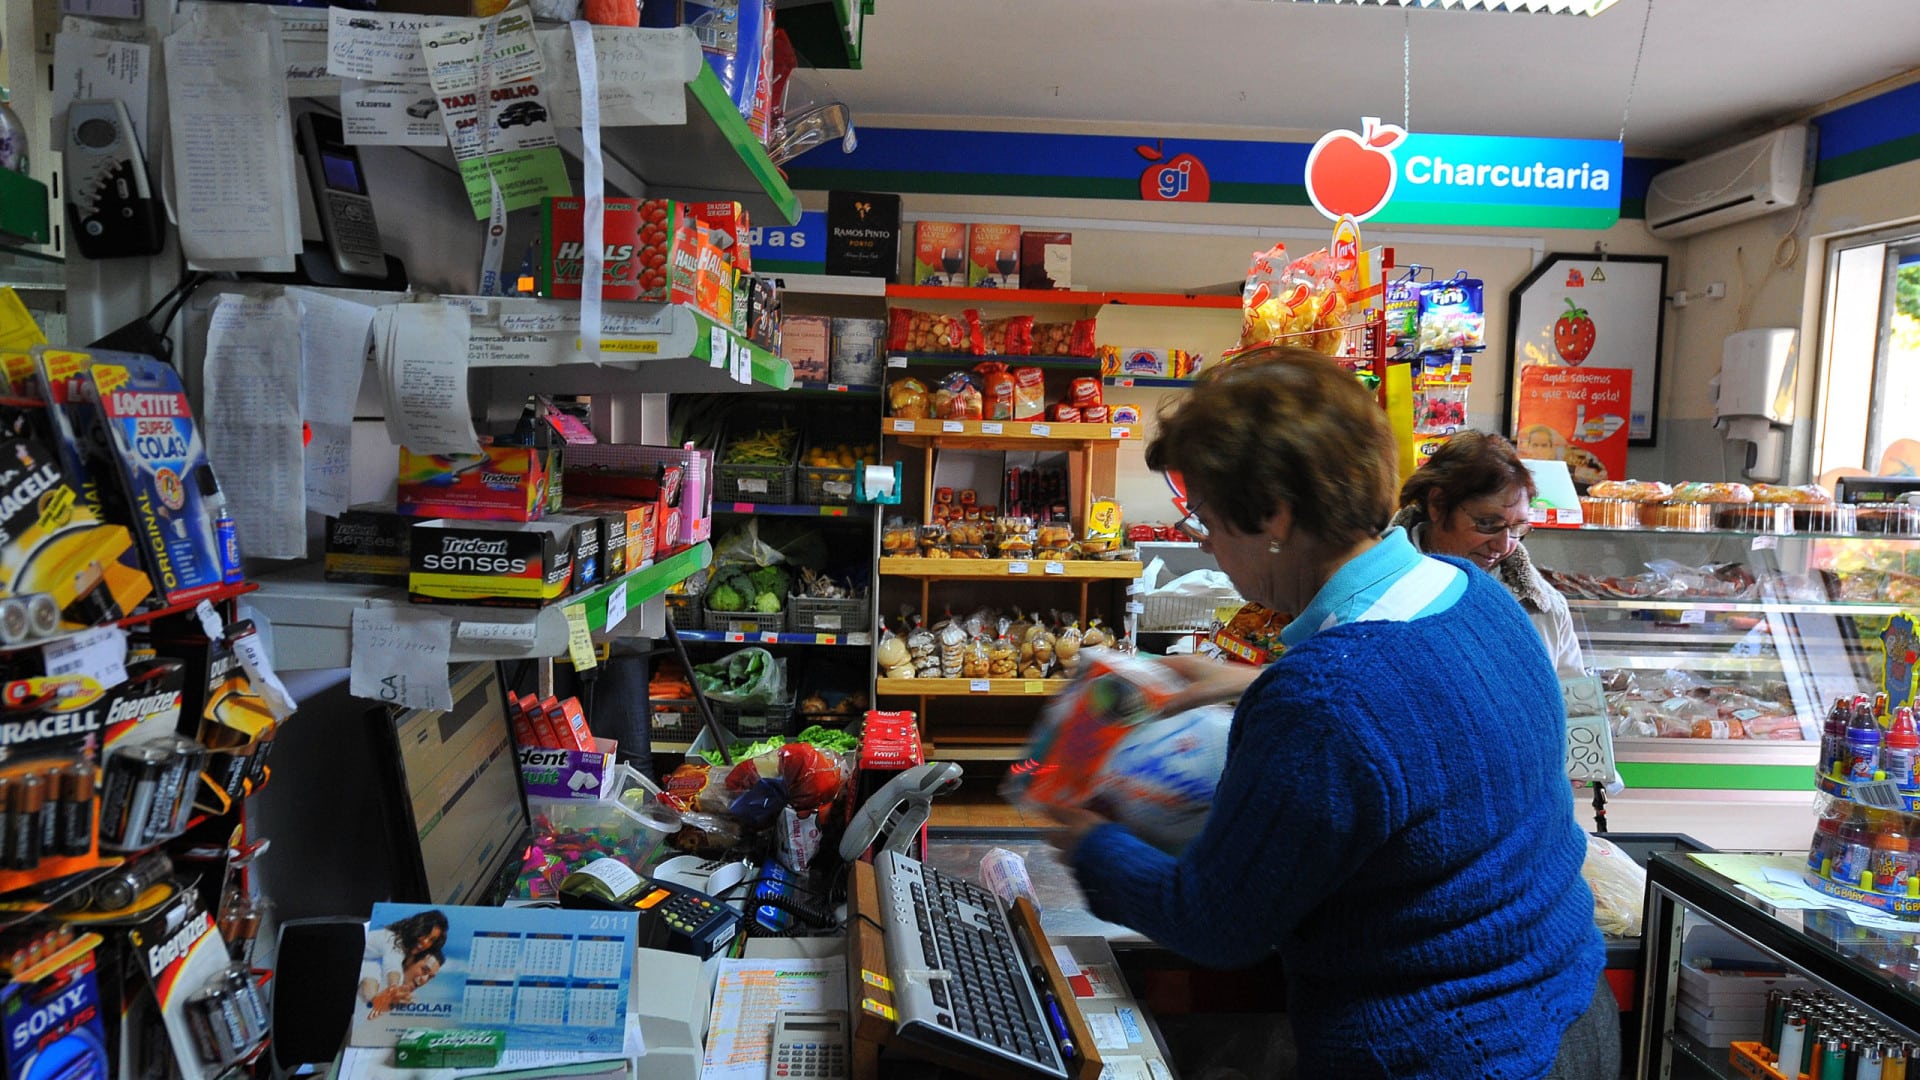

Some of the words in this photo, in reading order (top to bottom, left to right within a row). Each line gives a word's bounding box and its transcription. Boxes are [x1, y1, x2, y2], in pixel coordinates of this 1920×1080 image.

[442, 93, 477, 109] TAXI
[490, 84, 539, 101] OELHO
[1158, 161, 1191, 198] gi
[1404, 155, 1610, 191] Charcutaria
[834, 227, 864, 238] RAMOS
[865, 229, 891, 239] PINTO
[1432, 289, 1463, 305] Fini
[1542, 370, 1567, 386] aqui
[1571, 373, 1612, 385] sabemos
[112, 393, 180, 416] LOCTITE
[1542, 389, 1562, 403] que
[1566, 387, 1588, 400] você
[1591, 389, 1620, 403] gosta!
[138, 420, 174, 435] SUPER
[480, 472, 521, 484] Trident
[137, 488, 177, 589] ORIGINAL
[332, 534, 394, 547] senses
[443, 536, 507, 556] Trident
[423, 554, 527, 574] senses
[547, 566, 571, 584] senses
[105, 690, 182, 726] Energizer
[1841, 889, 1865, 902] BABY
[589, 915, 629, 930] 2011
[147, 911, 209, 977] Energizer
[13, 983, 88, 1051] SONY
